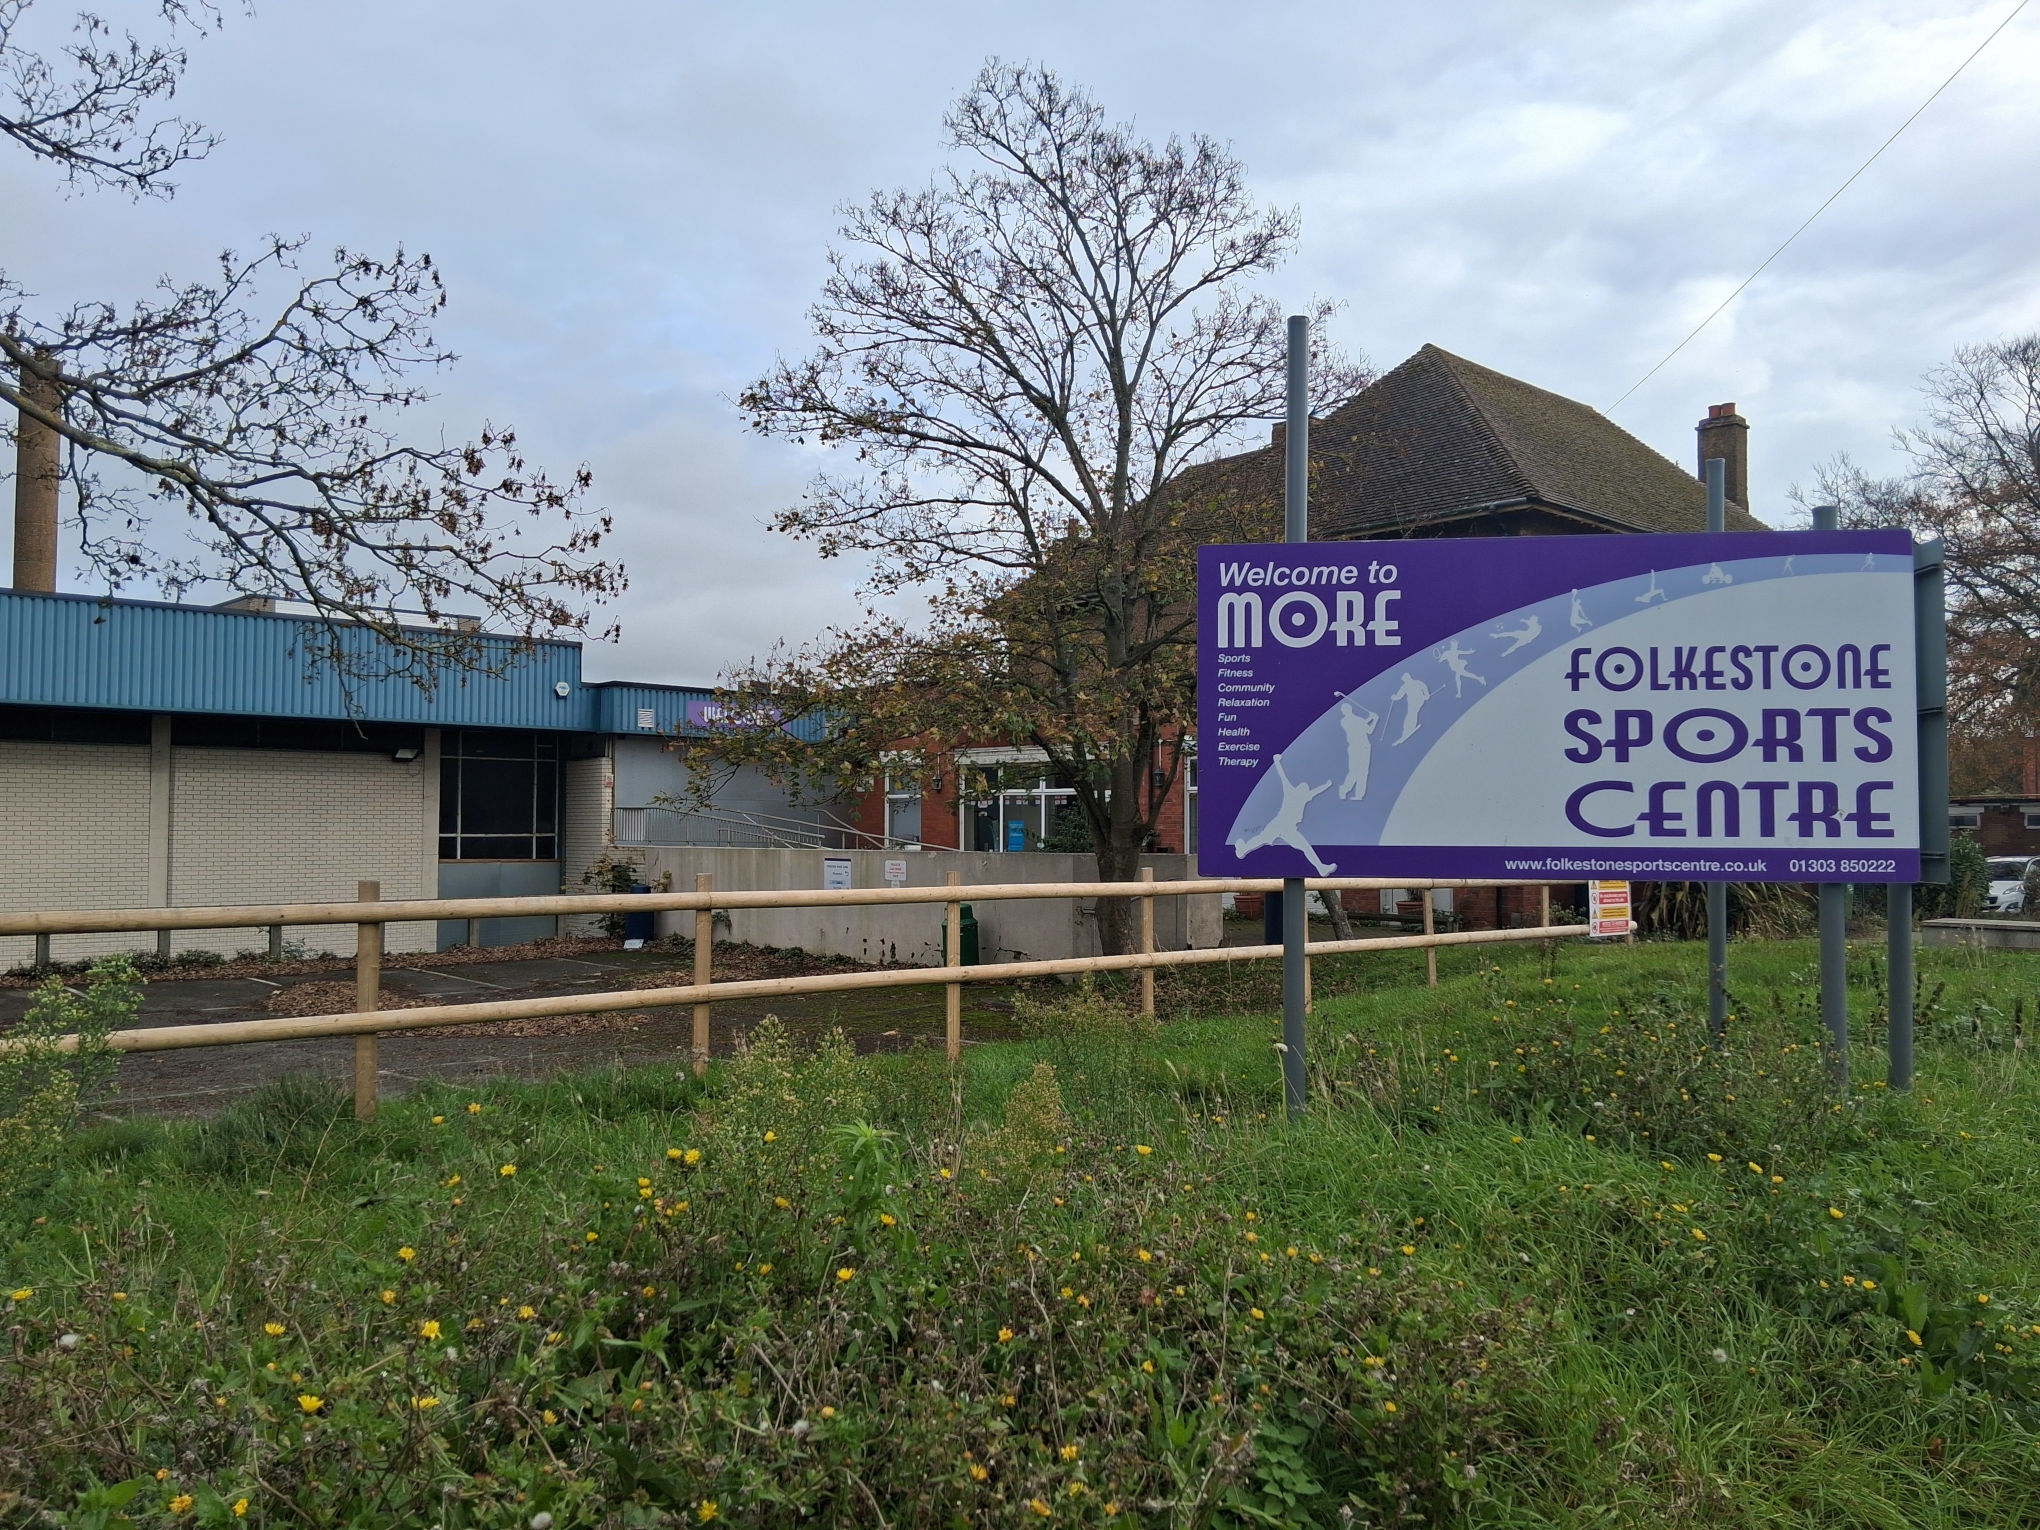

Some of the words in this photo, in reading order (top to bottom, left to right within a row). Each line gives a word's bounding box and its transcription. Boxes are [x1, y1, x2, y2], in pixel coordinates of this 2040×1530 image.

[1218, 561, 1358, 587] Welcome
[1367, 560, 1398, 585] to
[1217, 590, 1401, 648] MORE
[1217, 653, 1251, 665] Sports
[1217, 668, 1254, 678] Fitness
[1564, 643, 1892, 692] FOLKESTONE
[1217, 683, 1276, 694] Community
[1217, 698, 1270, 707] Relaxation
[1217, 712, 1237, 722] Fun
[1217, 727, 1251, 737] Health
[1563, 707, 1893, 764] SPORTS
[1217, 742, 1261, 752] Exercise
[1218, 756, 1259, 768] Therapy
[1564, 780, 1895, 838] CENTRE
[1504, 857, 1768, 874] www.folkestonesportscentre.co.uk
[1789, 859, 1836, 873] 01303
[1840, 859, 1896, 873] 850222
